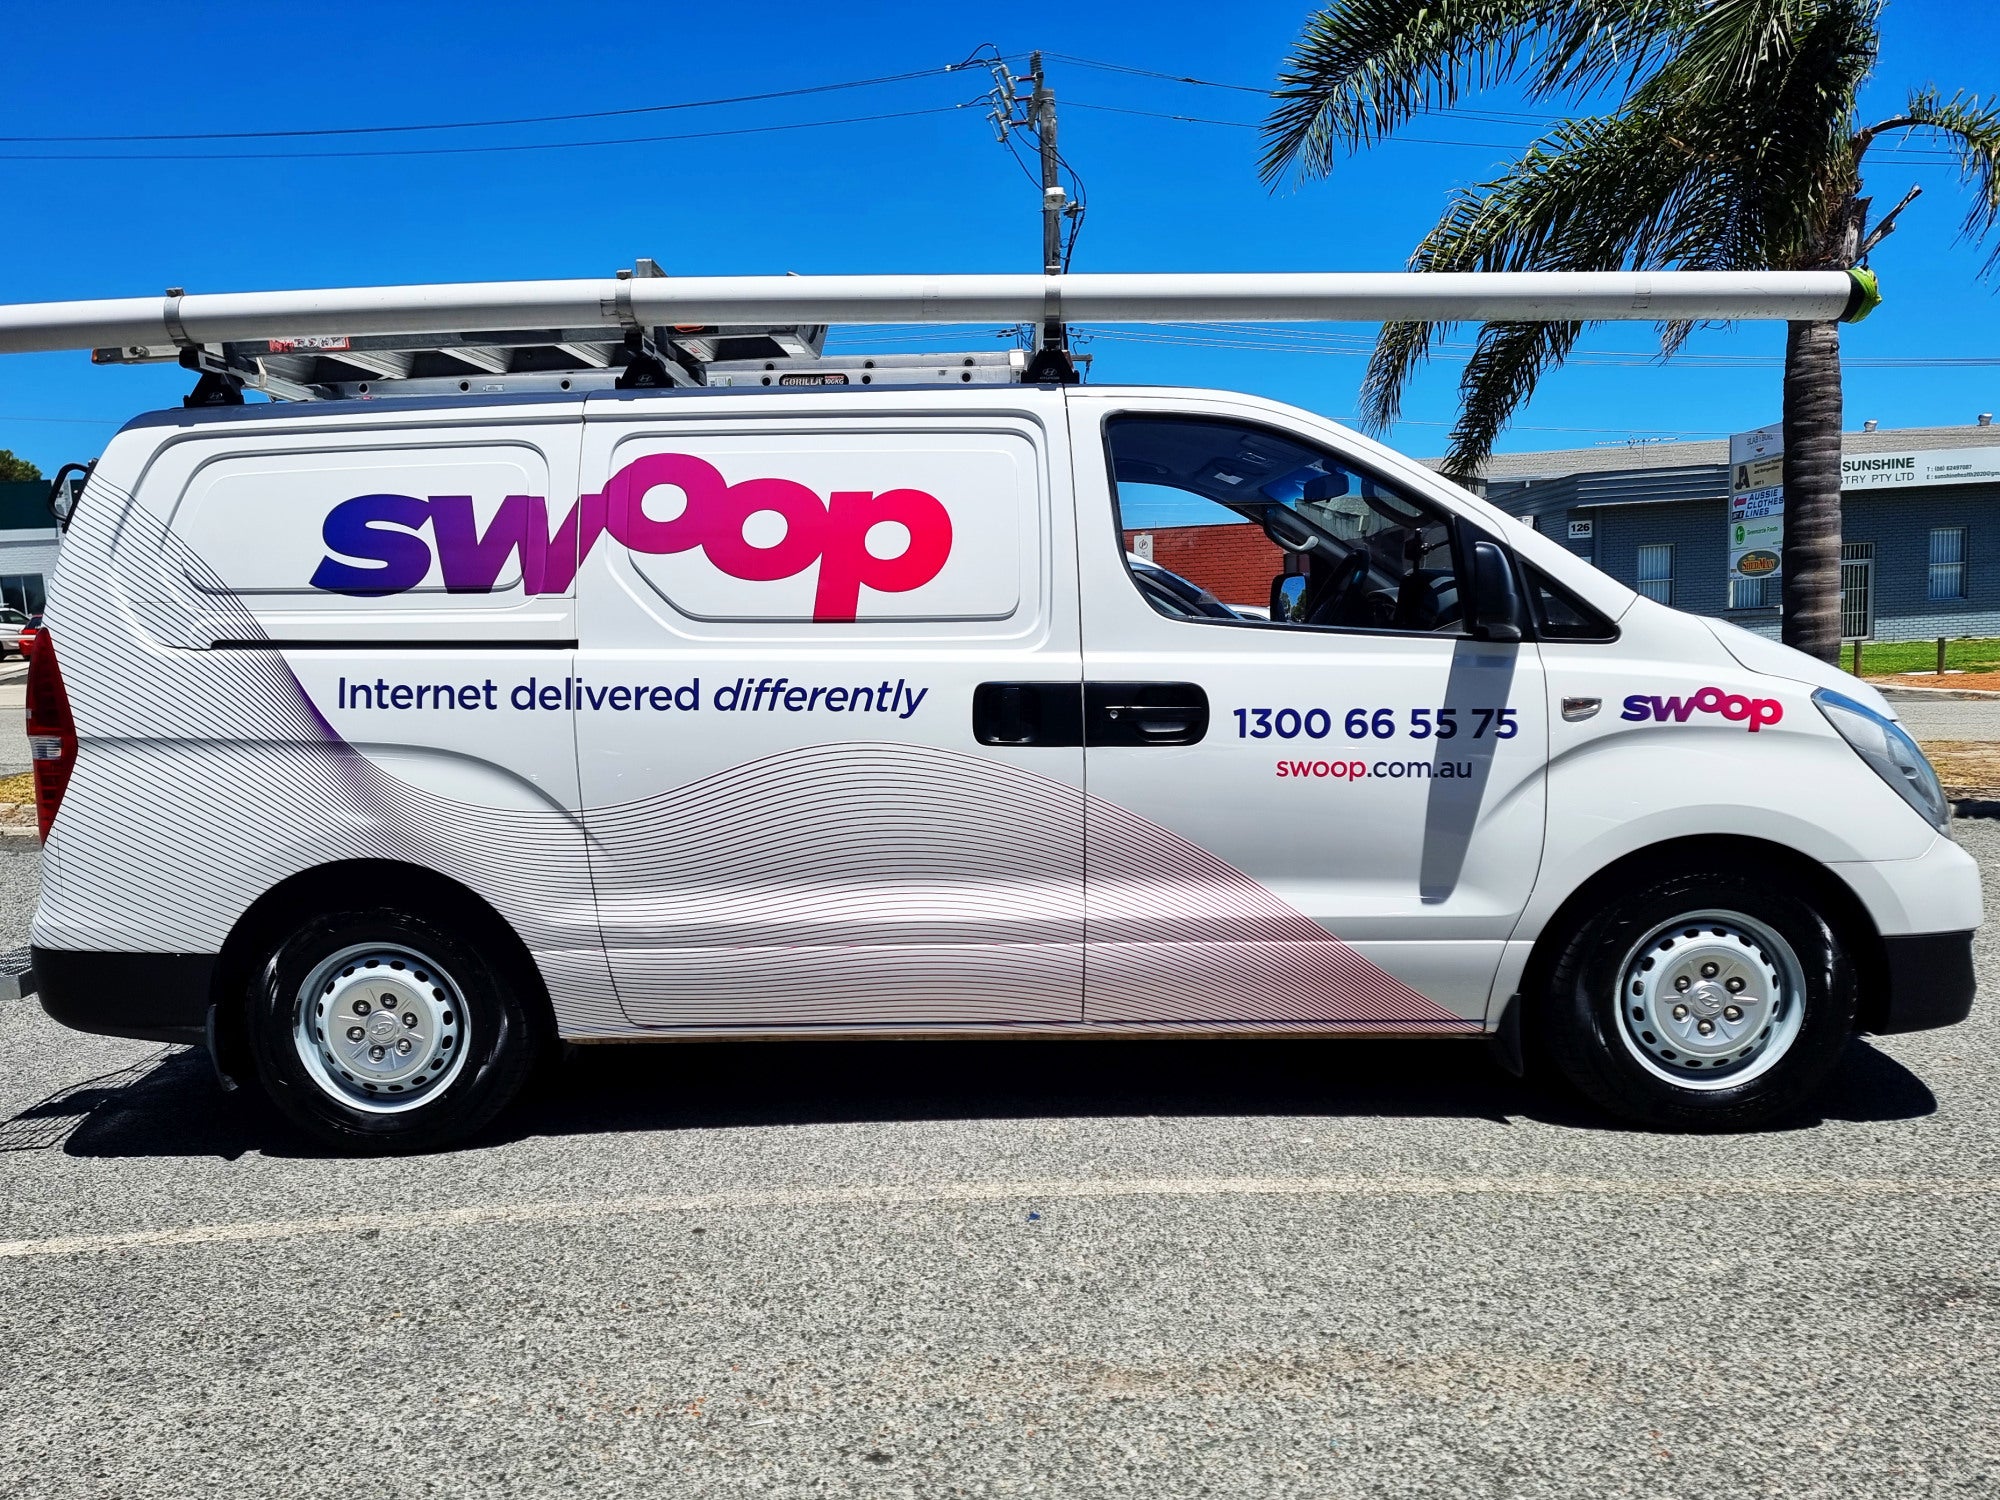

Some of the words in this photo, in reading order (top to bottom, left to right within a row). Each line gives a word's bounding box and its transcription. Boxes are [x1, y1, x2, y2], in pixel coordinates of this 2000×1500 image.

[783, 376, 823, 386] GORILLA
[1842, 457, 1915, 472] SUNSHINE
[1872, 473, 1892, 483] PTY
[1895, 472, 1915, 482] LTD
[1748, 489, 1778, 501] AUSSIE
[1747, 496, 1784, 510] CLOTHES
[1745, 507, 1770, 518] LINES
[1571, 523, 1590, 532] 126
[310, 453, 952, 623] swoop
[338, 677, 498, 710] Internet
[510, 677, 700, 711] delivered
[713, 677, 929, 719] differently
[1621, 687, 1783, 732] swoop
[1233, 708, 1331, 739] 1300
[1344, 708, 1395, 739] 66
[1409, 708, 1458, 739] 55
[1472, 708, 1519, 739] 75
[1276, 760, 1472, 782] swoop.com.au
